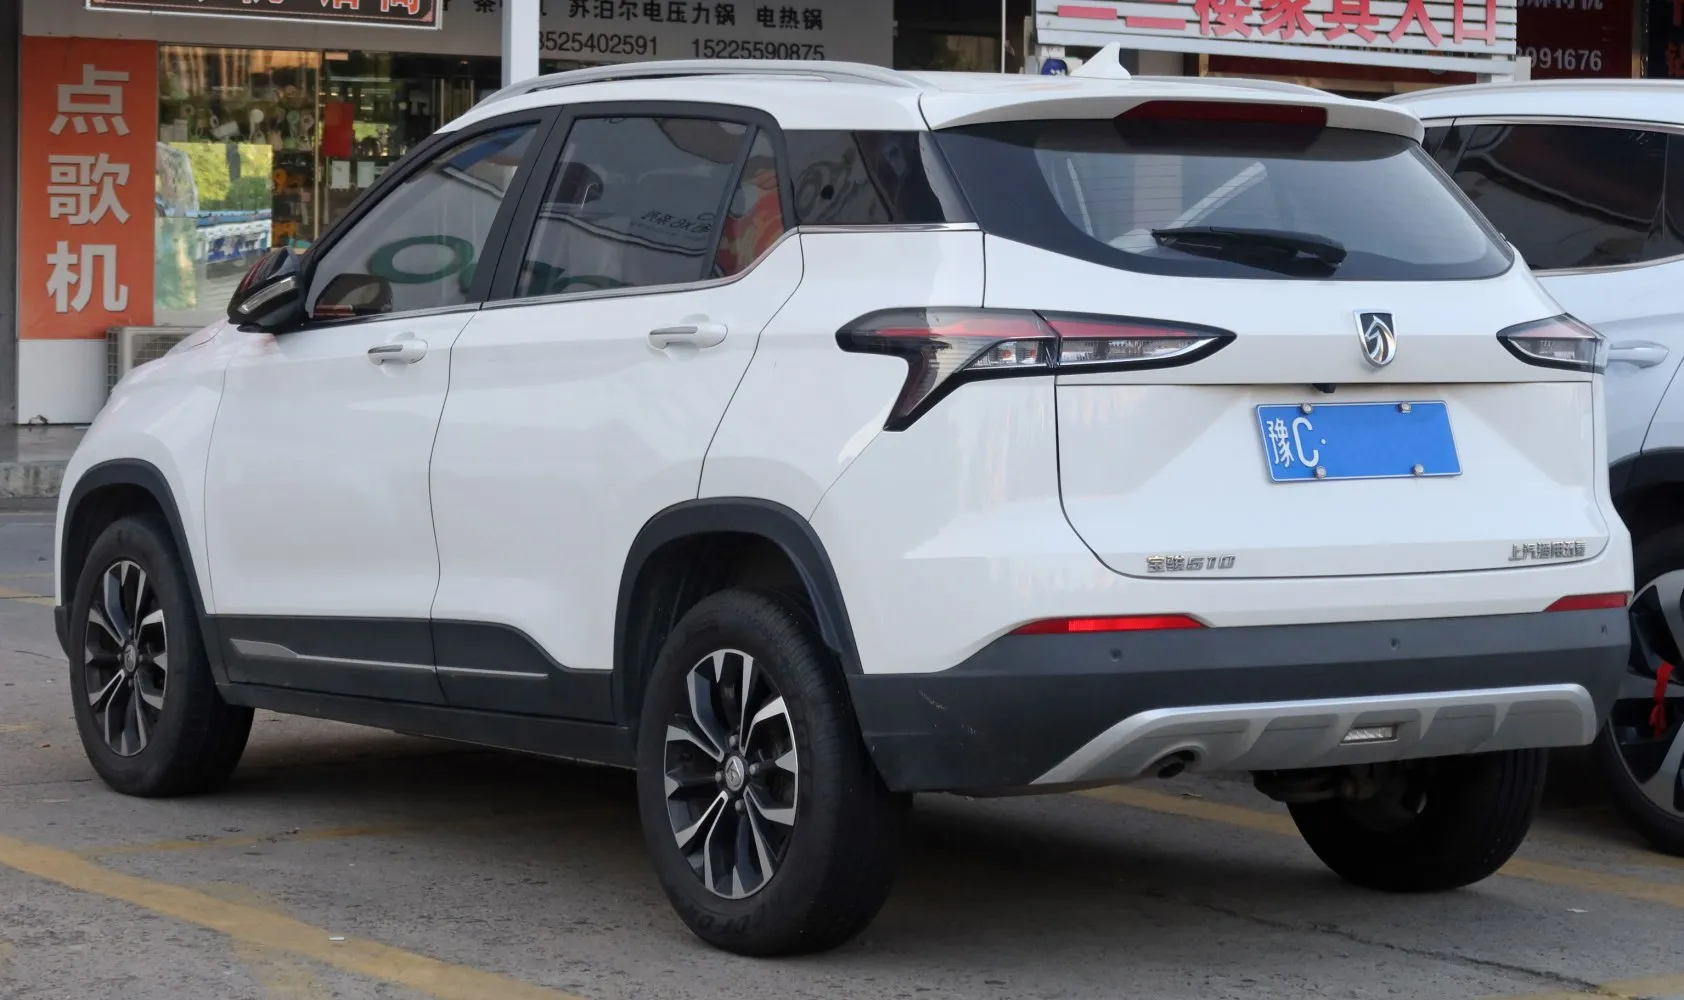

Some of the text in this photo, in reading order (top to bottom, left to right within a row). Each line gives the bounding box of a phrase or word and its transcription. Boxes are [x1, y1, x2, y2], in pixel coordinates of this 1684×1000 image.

[756, 5, 823, 31] 电热锅
[692, 38, 825, 60] 15225590875
[1516, 46, 1602, 71] 991676
[47, 64, 130, 314] 点歌机
